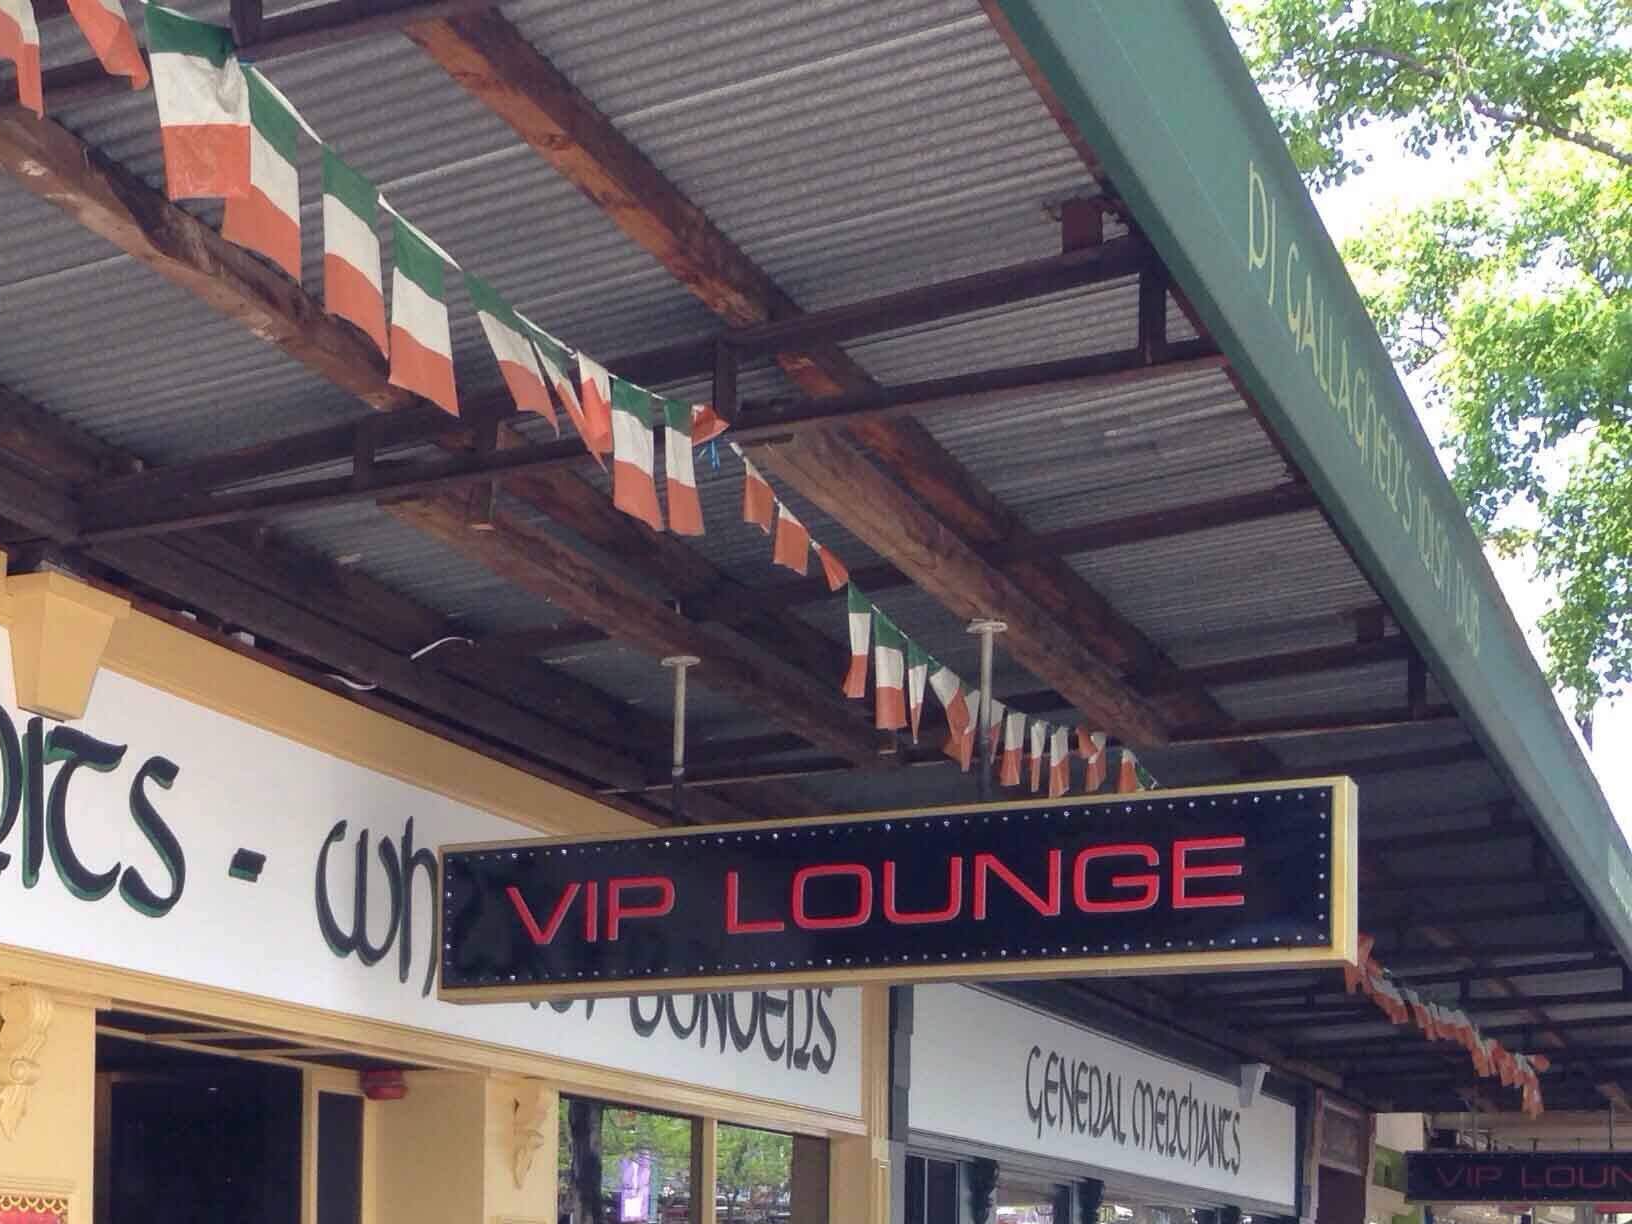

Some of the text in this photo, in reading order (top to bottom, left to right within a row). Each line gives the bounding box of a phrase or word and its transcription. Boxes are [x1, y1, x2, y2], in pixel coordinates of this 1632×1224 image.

[506, 875, 676, 946] VIP
[725, 836, 1246, 934] LOUNGE
[1025, 1045, 1127, 1146] GENERAL
[1436, 1167, 1502, 1188] VIP
